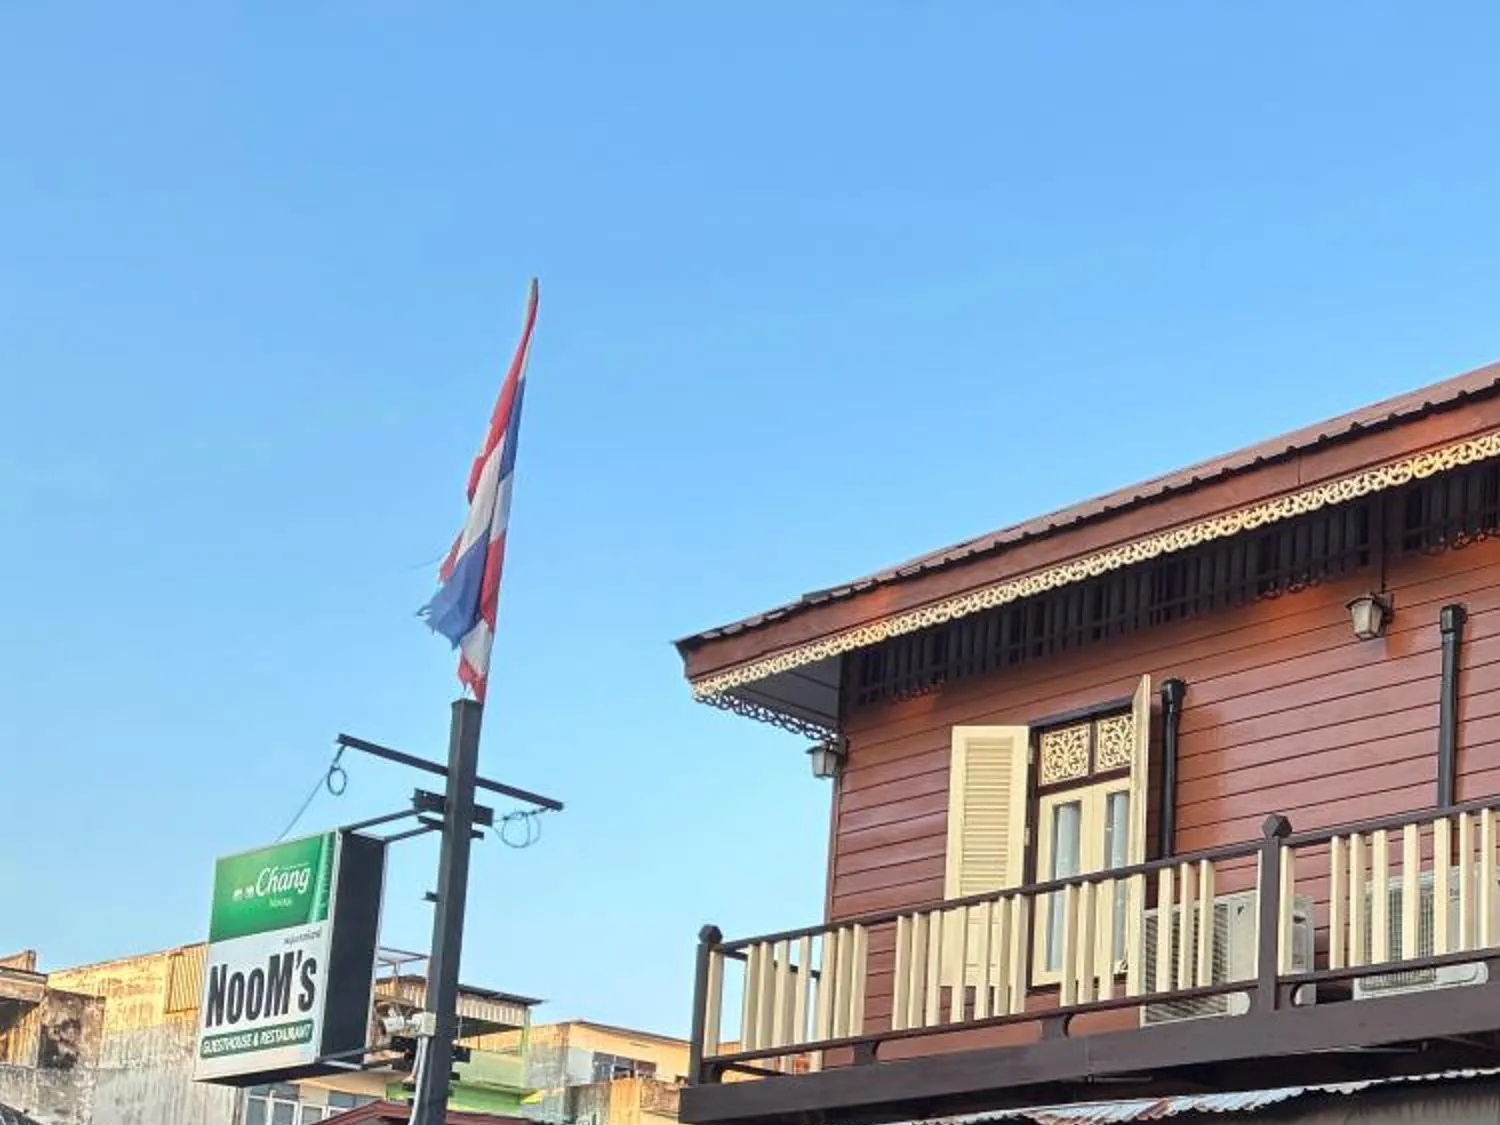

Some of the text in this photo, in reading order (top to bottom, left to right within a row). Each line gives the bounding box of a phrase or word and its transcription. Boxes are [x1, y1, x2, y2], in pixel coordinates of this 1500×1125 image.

[256, 865, 311, 896] Chang
[202, 1032, 253, 1054] GUESTHOUSE
[260, 1023, 314, 1045] RESTAURANT
